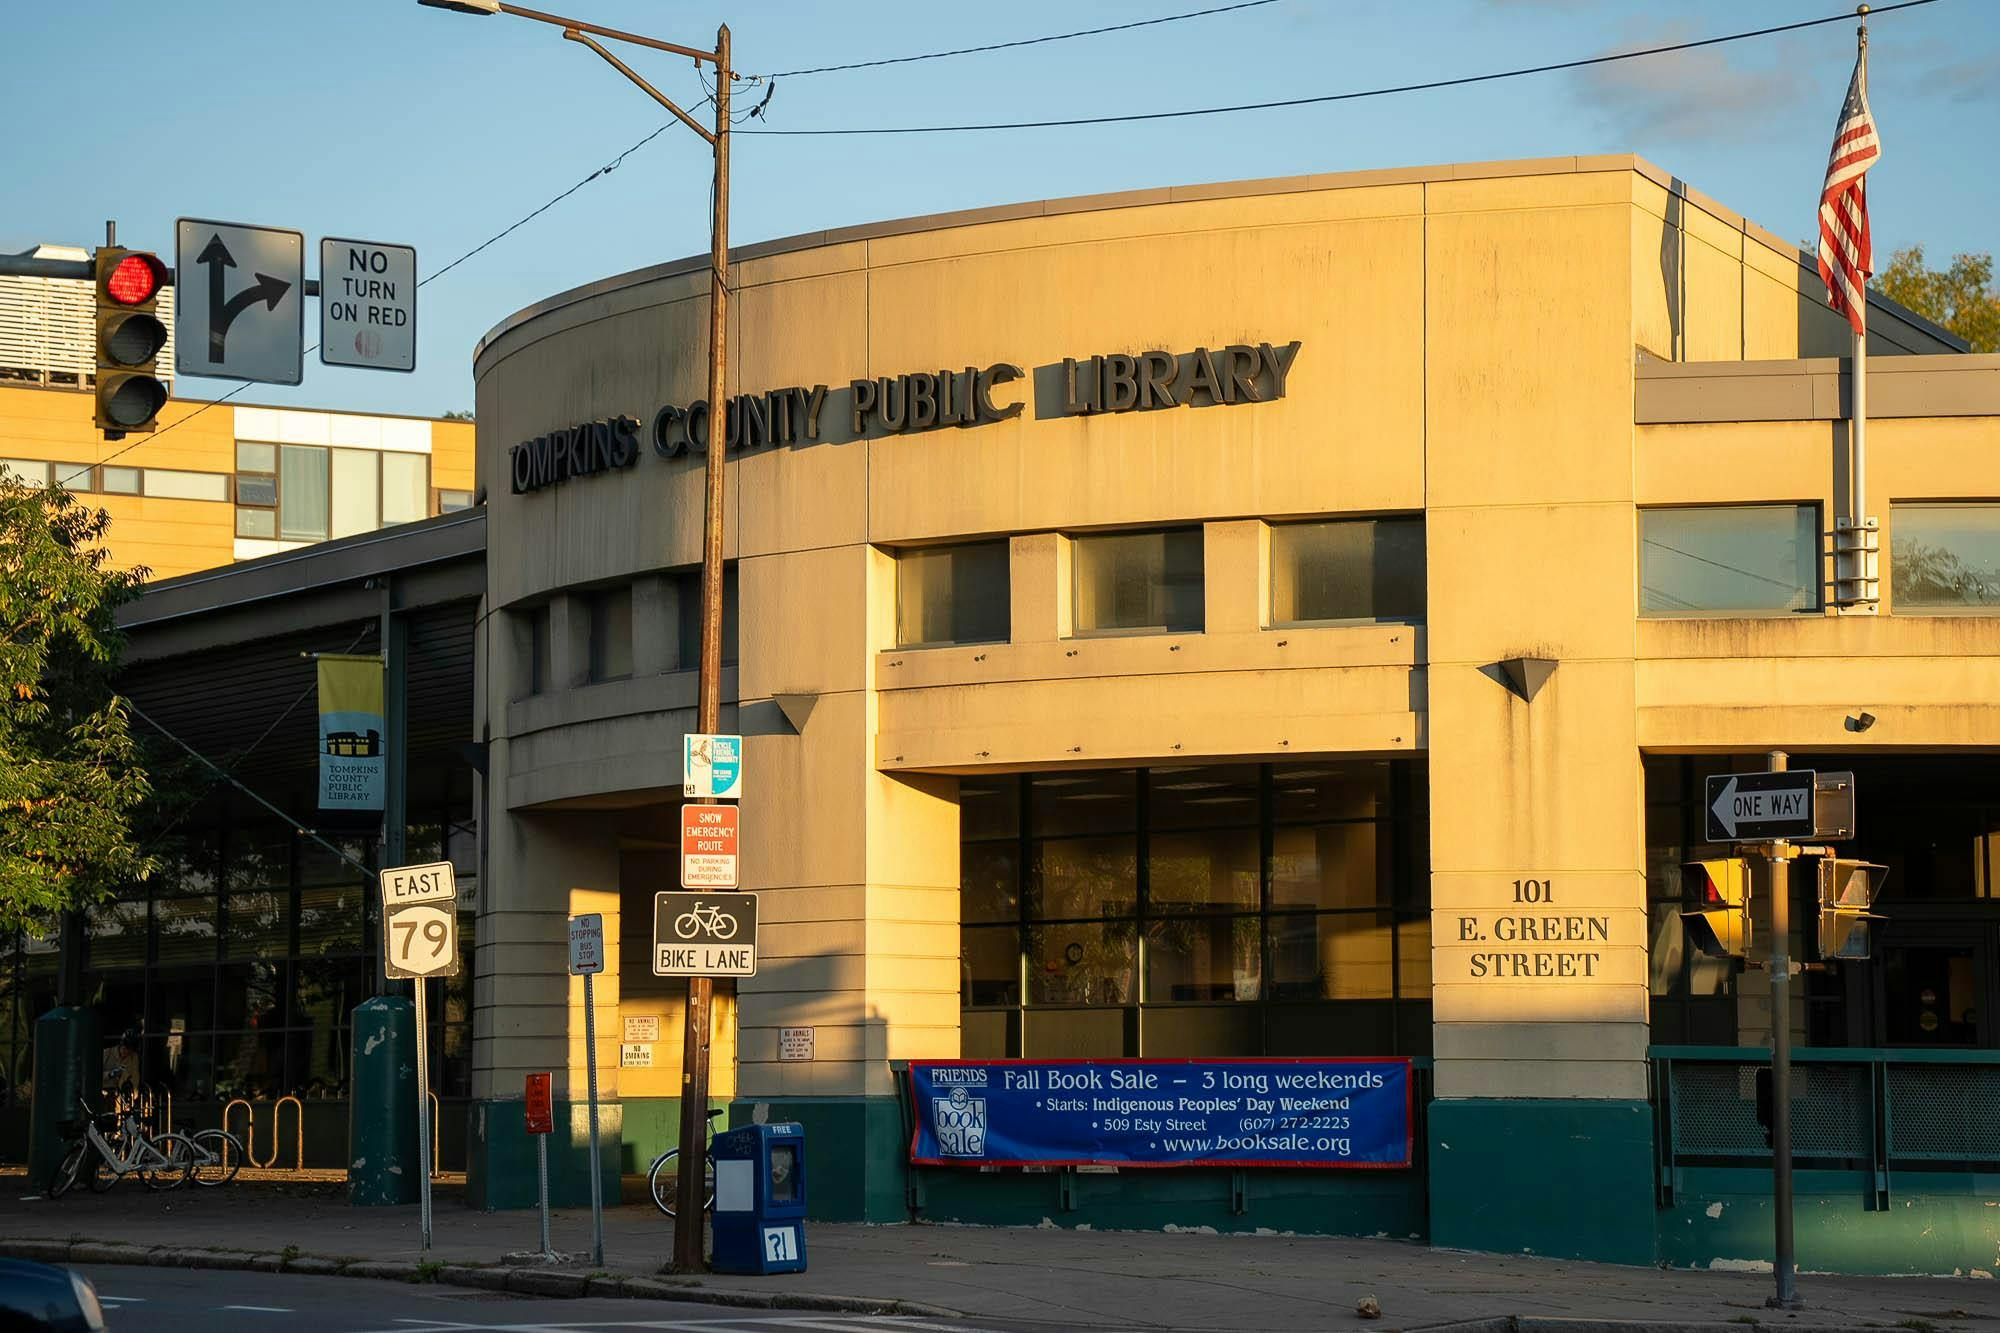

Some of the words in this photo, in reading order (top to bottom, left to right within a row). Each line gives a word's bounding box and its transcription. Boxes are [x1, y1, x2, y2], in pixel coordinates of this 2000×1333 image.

[350, 248, 388, 274] NO
[342, 277, 396, 300] TURN
[330, 302, 357, 322] ON
[368, 305, 407, 327] RED
[508, 414, 642, 494] TOMPKINS
[652, 384, 828, 457] COUNTY
[850, 362, 1025, 433] PUBLIC
[1062, 341, 1302, 415] LIBRARY
[328, 774, 369, 783] COUNTY
[329, 765, 379, 775] TOMPKINS
[328, 783, 362, 792] PUBLIC
[328, 792, 370, 801] LIBRARY
[1734, 796, 1762, 817] ONE
[1771, 793, 1803, 815] WAY
[698, 812, 722, 824] SNOW
[686, 826, 735, 838] EMERGENCY
[697, 840, 724, 851] ROUTE
[394, 872, 440, 896] EAST
[687, 873, 733, 881] EMERGENCIES
[1512, 879, 1553, 903] 101
[581, 919, 590, 928] NO
[1457, 917, 1486, 941] E.
[1494, 917, 1609, 941] GREEN
[392, 920, 448, 960] 79
[571, 928, 601, 940] STOPPING
[580, 942, 593, 951] BUS
[578, 951, 594, 960] STOP
[660, 949, 697, 968] BIKE
[705, 950, 749, 968] LANE
[1470, 953, 1599, 977] STREET
[931, 1069, 988, 1082] FRIENDS
[1004, 1070, 1040, 1090] Fall
[1047, 1069, 1103, 1090] Book
[1110, 1070, 1158, 1090] Sale
[1202, 1072, 1215, 1089] 3
[1223, 1071, 1269, 1094] long
[1275, 1071, 1383, 1089] weekends
[1047, 1098, 1088, 1111] Starts:
[1093, 1097, 1174, 1114] Indigenous
[1178, 1097, 1241, 1114] Peoples'
[1246, 1098, 1275, 1114] Day
[1279, 1097, 1350, 1111] Weekend
[935, 1101, 983, 1128] book
[772, 1126, 792, 1134] FREE
[1104, 1119, 1130, 1131] 509
[1134, 1118, 1162, 1134] Esty
[1165, 1118, 1207, 1131] Street
[1239, 1117, 1275, 1132] (607)
[1280, 1117, 1350, 1129] 272-2223
[940, 1128, 981, 1154] sale
[1163, 1133, 1351, 1156] www.booksale.org
